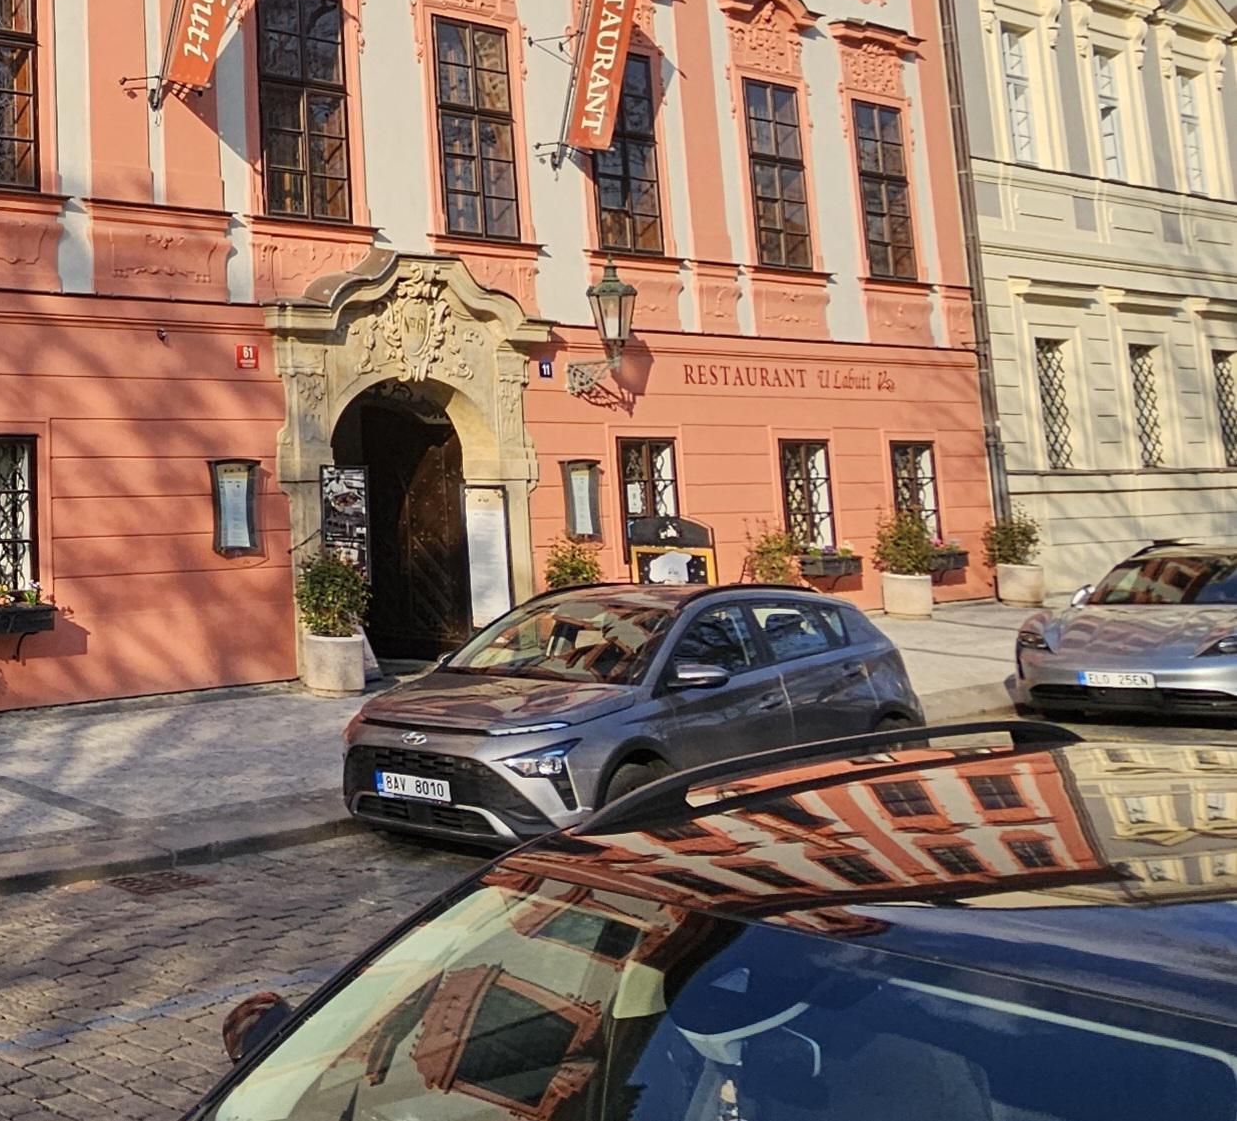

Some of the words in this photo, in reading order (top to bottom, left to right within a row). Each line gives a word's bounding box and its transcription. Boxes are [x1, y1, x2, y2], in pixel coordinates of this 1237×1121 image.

[541, 363, 551, 376] 11
[683, 364, 807, 388] RESTAURANT
[817, 370, 830, 388] U
[386, 775, 405, 791] 8AV
[415, 780, 444, 797] 8010
